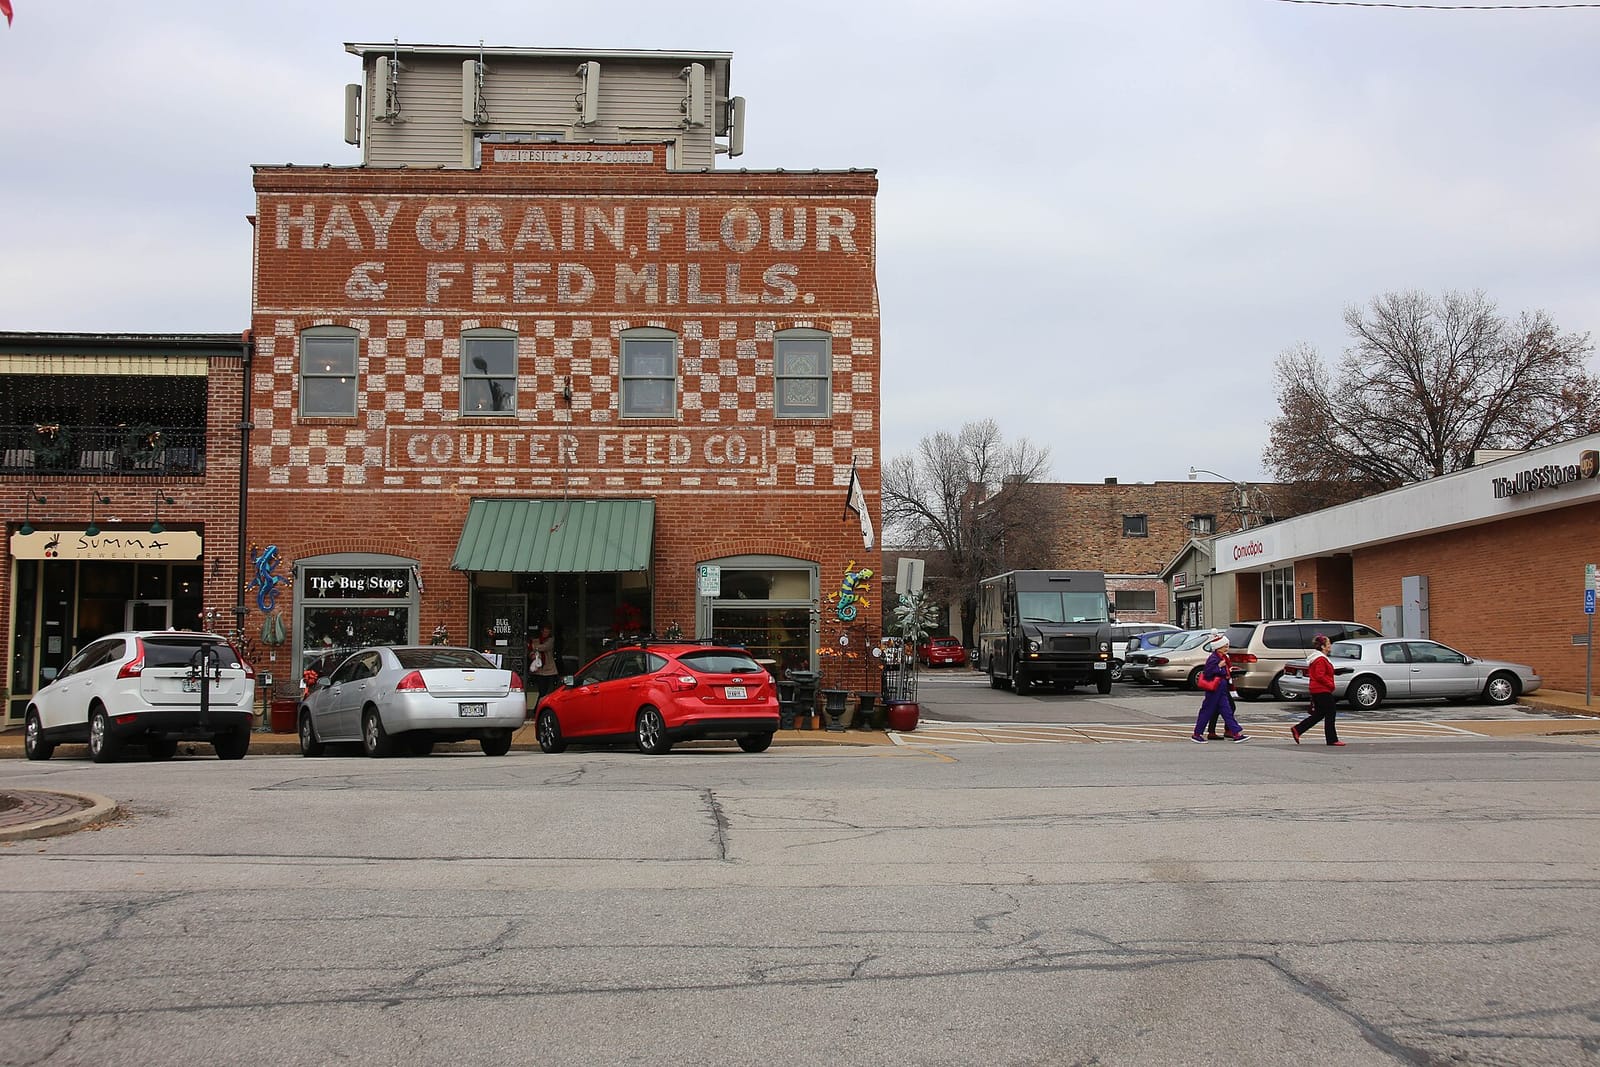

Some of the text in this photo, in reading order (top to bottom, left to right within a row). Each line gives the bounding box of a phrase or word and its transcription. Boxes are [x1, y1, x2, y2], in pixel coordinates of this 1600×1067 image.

[571, 151, 592, 162] 1912
[606, 151, 649, 163] COULTER
[275, 201, 401, 250] HAY
[647, 206, 858, 253] FLOUR
[344, 261, 815, 304] & FEED MILLS.
[406, 433, 758, 465] COULTER FEED CO.
[1581, 458, 1593, 475] ups
[1492, 464, 1577, 499] The UPS Store
[76, 535, 169, 550] SUMMA
[310, 576, 404, 591] The Bug Store
[493, 625, 512, 634] STORE
[495, 618, 509, 626] BUG
